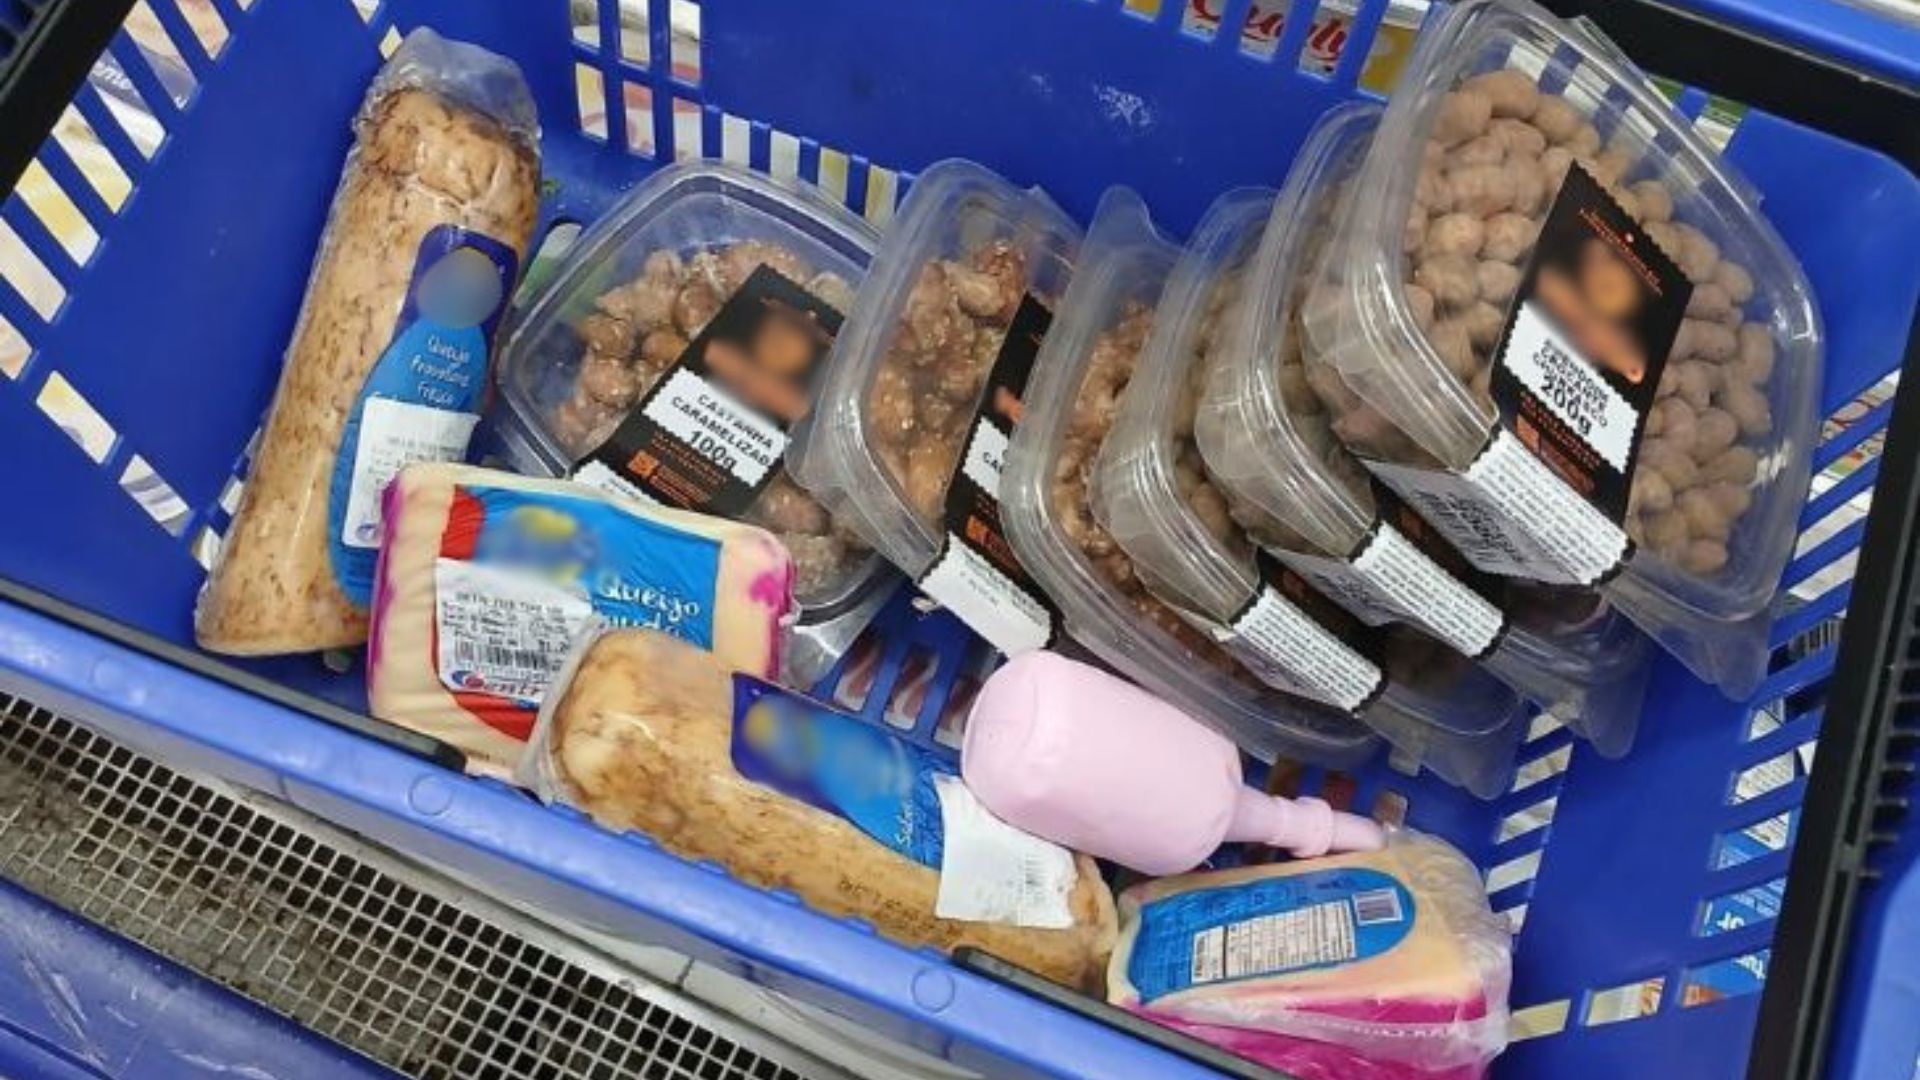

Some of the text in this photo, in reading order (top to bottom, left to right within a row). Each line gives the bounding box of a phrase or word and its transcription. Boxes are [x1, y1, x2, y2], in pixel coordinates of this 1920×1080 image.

[1540, 374, 1594, 435] 200g
[689, 430, 737, 469] 100g
[598, 576, 699, 622] Queijo
